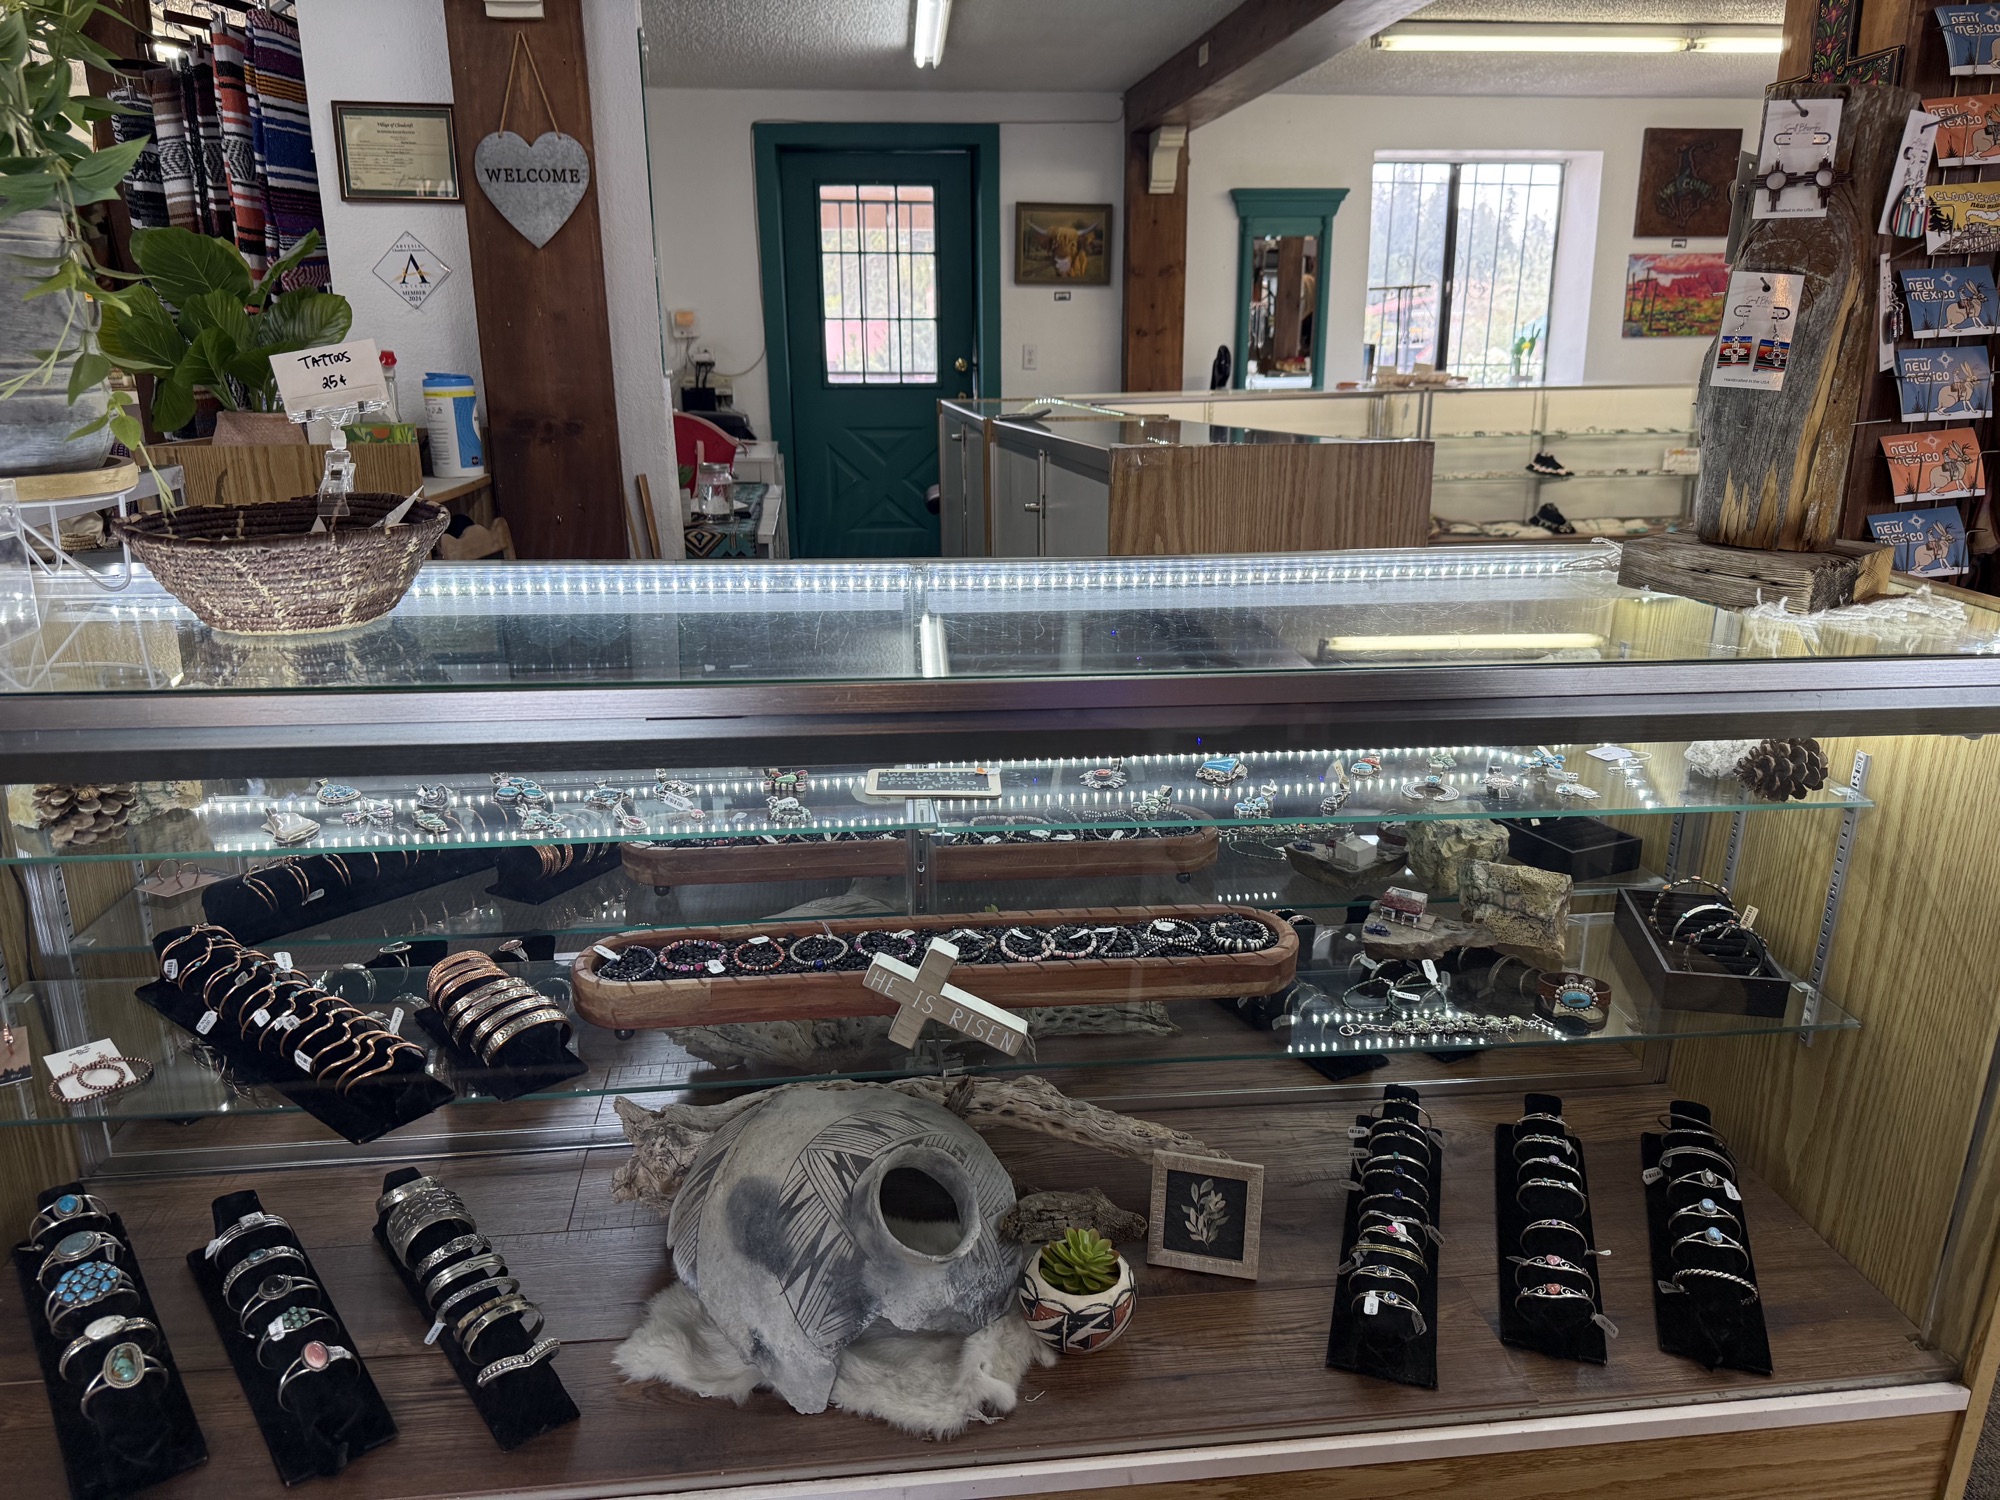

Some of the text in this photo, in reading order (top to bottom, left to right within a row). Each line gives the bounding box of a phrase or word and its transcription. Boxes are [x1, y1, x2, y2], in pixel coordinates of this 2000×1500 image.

[484, 168, 580, 183] WELCOME
[1908, 279, 1935, 291] NEW
[297, 351, 351, 370] TATTOOS
[1905, 359, 1932, 371] NEW
[322, 374, 347, 389] 25¢
[1890, 441, 1919, 455] NEW
[1877, 521, 1903, 534] NEW
[870, 970, 1016, 1052] HE IS RISEN
